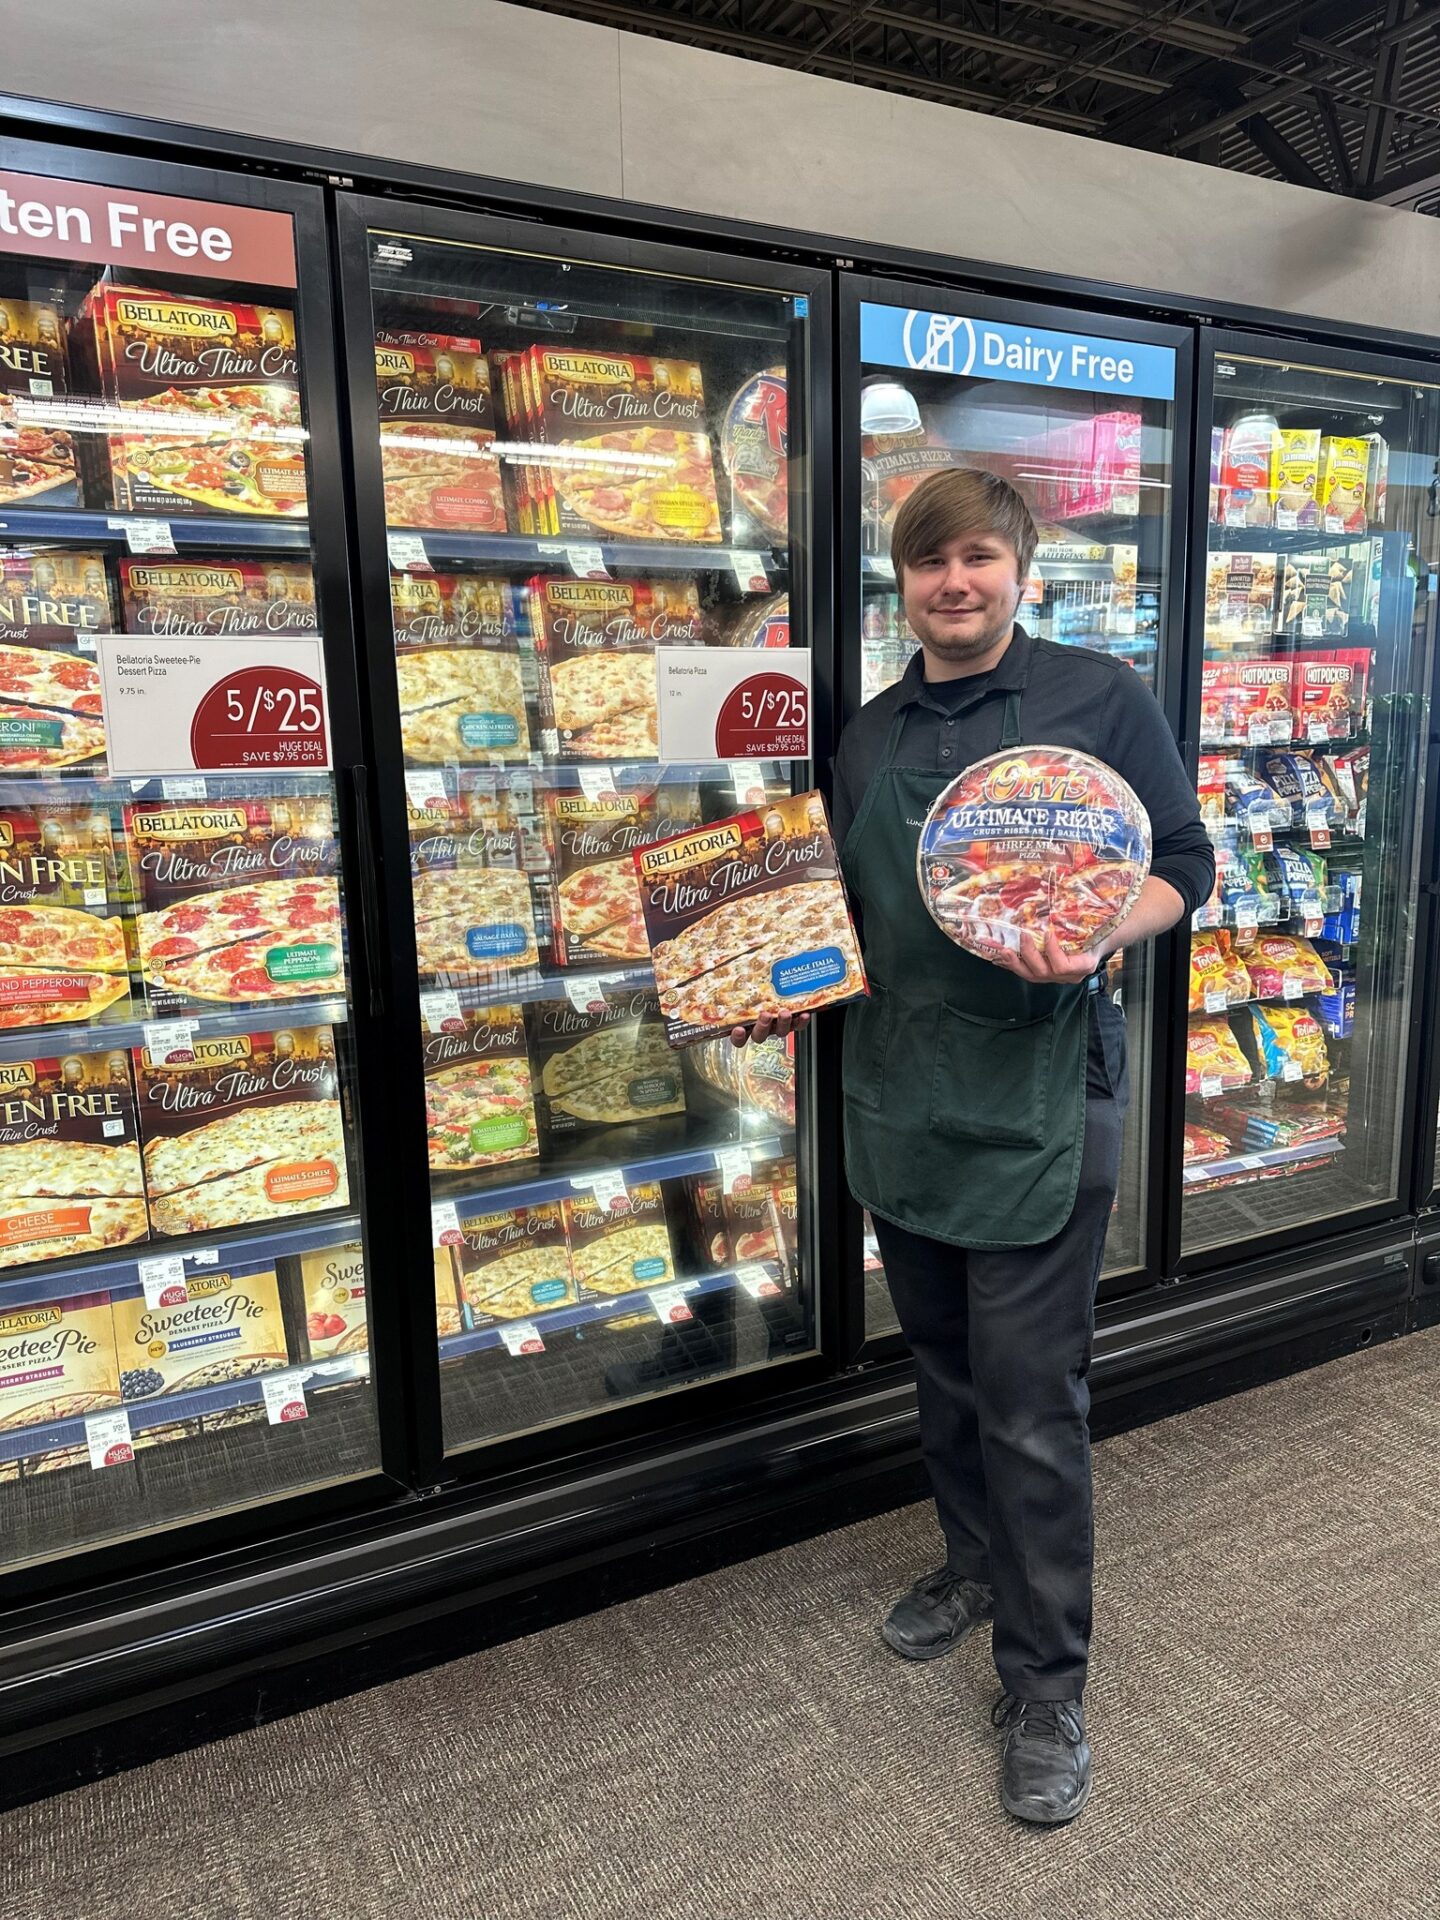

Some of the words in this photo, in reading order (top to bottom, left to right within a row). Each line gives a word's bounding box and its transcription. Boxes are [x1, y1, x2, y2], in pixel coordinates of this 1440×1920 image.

[0, 189, 91, 244] ten
[108, 201, 232, 262] Free
[124, 304, 232, 330] BELLATORIA
[418, 334, 438, 346] Crust
[125, 342, 200, 376] Ultra
[199, 348, 256, 378] Thin
[983, 332, 1062, 381] Dairy
[1072, 345, 1134, 383] Free
[549, 356, 631, 378] BELLATORIA
[382, 386, 431, 413] Thin
[435, 384, 485, 413] Crust
[551, 389, 608, 419] Ultra
[607, 394, 650, 419] Thin
[653, 392, 699, 419] Crust
[919, 450, 954, 462] RIZER
[260, 467, 291, 475] ULTIMATE
[135, 570, 239, 589] BELLATORIA
[551, 586, 629, 602] BELLATORIA
[21, 596, 98, 629] FREE
[138, 606, 207, 636] Ultra
[207, 606, 262, 636] Thin
[410, 615, 457, 642] Thin
[460, 610, 510, 638] Crust
[553, 617, 607, 646] Ultra
[606, 619, 648, 645] Thin
[651, 613, 695, 641] Crust
[117, 655, 153, 665] Bellatoria
[154, 656, 201, 665] Sweetee-Pie
[118, 667, 147, 676] Dessert
[148, 667, 167, 676] Pizza
[668, 667, 693, 675] Bellatoria
[1242, 667, 1257, 684] HOT
[1257, 667, 1288, 684] POCKETS
[1308, 667, 1321, 683] HOT
[1321, 667, 1351, 683] POCKETS
[279, 742, 302, 751] HUGE
[303, 741, 323, 751] DEAL
[746, 744, 765, 752] SAVE
[767, 744, 789, 752] $29.95
[801, 743, 806, 751] 5
[776, 735, 791, 744] HUGE
[792, 735, 805, 744] DEAL
[243, 752, 270, 761] SAVE
[273, 752, 298, 761] $9.95
[317, 752, 323, 760] 5
[985, 760, 1089, 804] Orv's
[560, 799, 635, 813] BELLATORIA
[139, 813, 242, 832] BELLATORIA
[948, 807, 1049, 829] ULTIMATE
[1055, 808, 1116, 831] RIZER
[973, 828, 999, 836] CRUST
[1004, 827, 1029, 835] RISES
[1032, 827, 1044, 835] AS
[419, 836, 465, 863] Thin
[468, 828, 516, 855] Crust
[562, 831, 613, 857] Ultra
[612, 826, 655, 852] Thin
[645, 830, 737, 869] BELLATORIA
[994, 841, 1032, 851] THREE
[1034, 841, 1069, 855] MEAT
[141, 852, 211, 883] Ultra
[210, 846, 265, 877] Thin
[270, 836, 328, 867] Crust
[1019, 852, 1041, 860] PIZZA
[0, 860, 24, 884] N
[30, 857, 105, 884] FREE
[651, 884, 711, 914] Ultra
[710, 860, 763, 896] Thin
[766, 835, 824, 874] Crust
[1284, 860, 1312, 874] PIZZA
[1, 885, 38, 901] Crust
[283, 956, 320, 964] PEPPERONI
[286, 950, 317, 958] ULTIMATE
[780, 965, 810, 977] SAUSAGE
[812, 957, 834, 968] ITALIA
[22, 977, 84, 988] PEPPERONI
[544, 1010, 590, 1033] Ultra
[426, 1035, 470, 1063] Thin
[473, 1025, 519, 1052] Crust
[0, 1067, 30, 1084] RIA
[149, 1082, 217, 1111] Ultra
[215, 1071, 269, 1102] Thin
[272, 1059, 328, 1090] Crust
[0, 1098, 46, 1124] EN
[51, 1093, 122, 1120] FREE
[24, 1122, 59, 1139] Crust
[270, 1175, 299, 1184] ULTIMATE
[307, 1169, 331, 1177] CHEESE
[7, 1213, 54, 1230] CHEESE
[464, 1211, 513, 1228] BELLATORIA
[574, 1211, 604, 1229] Ultra
[631, 1197, 658, 1214] Crust
[465, 1233, 499, 1251] Ultra
[498, 1225, 525, 1244] Thin
[526, 1217, 556, 1235] Crust
[162, 1290, 186, 1299] HUGE
[135, 1295, 264, 1344] Sweetee-Pie
[169, 1326, 200, 1336] DESSERT
[202, 1321, 223, 1329] PIZZA
[173, 1337, 207, 1348] BLUEBERRY
[28, 1356, 51, 1366] PIZZA
[283, 1405, 305, 1415] HUGE
[108, 1445, 131, 1458] HUGE
